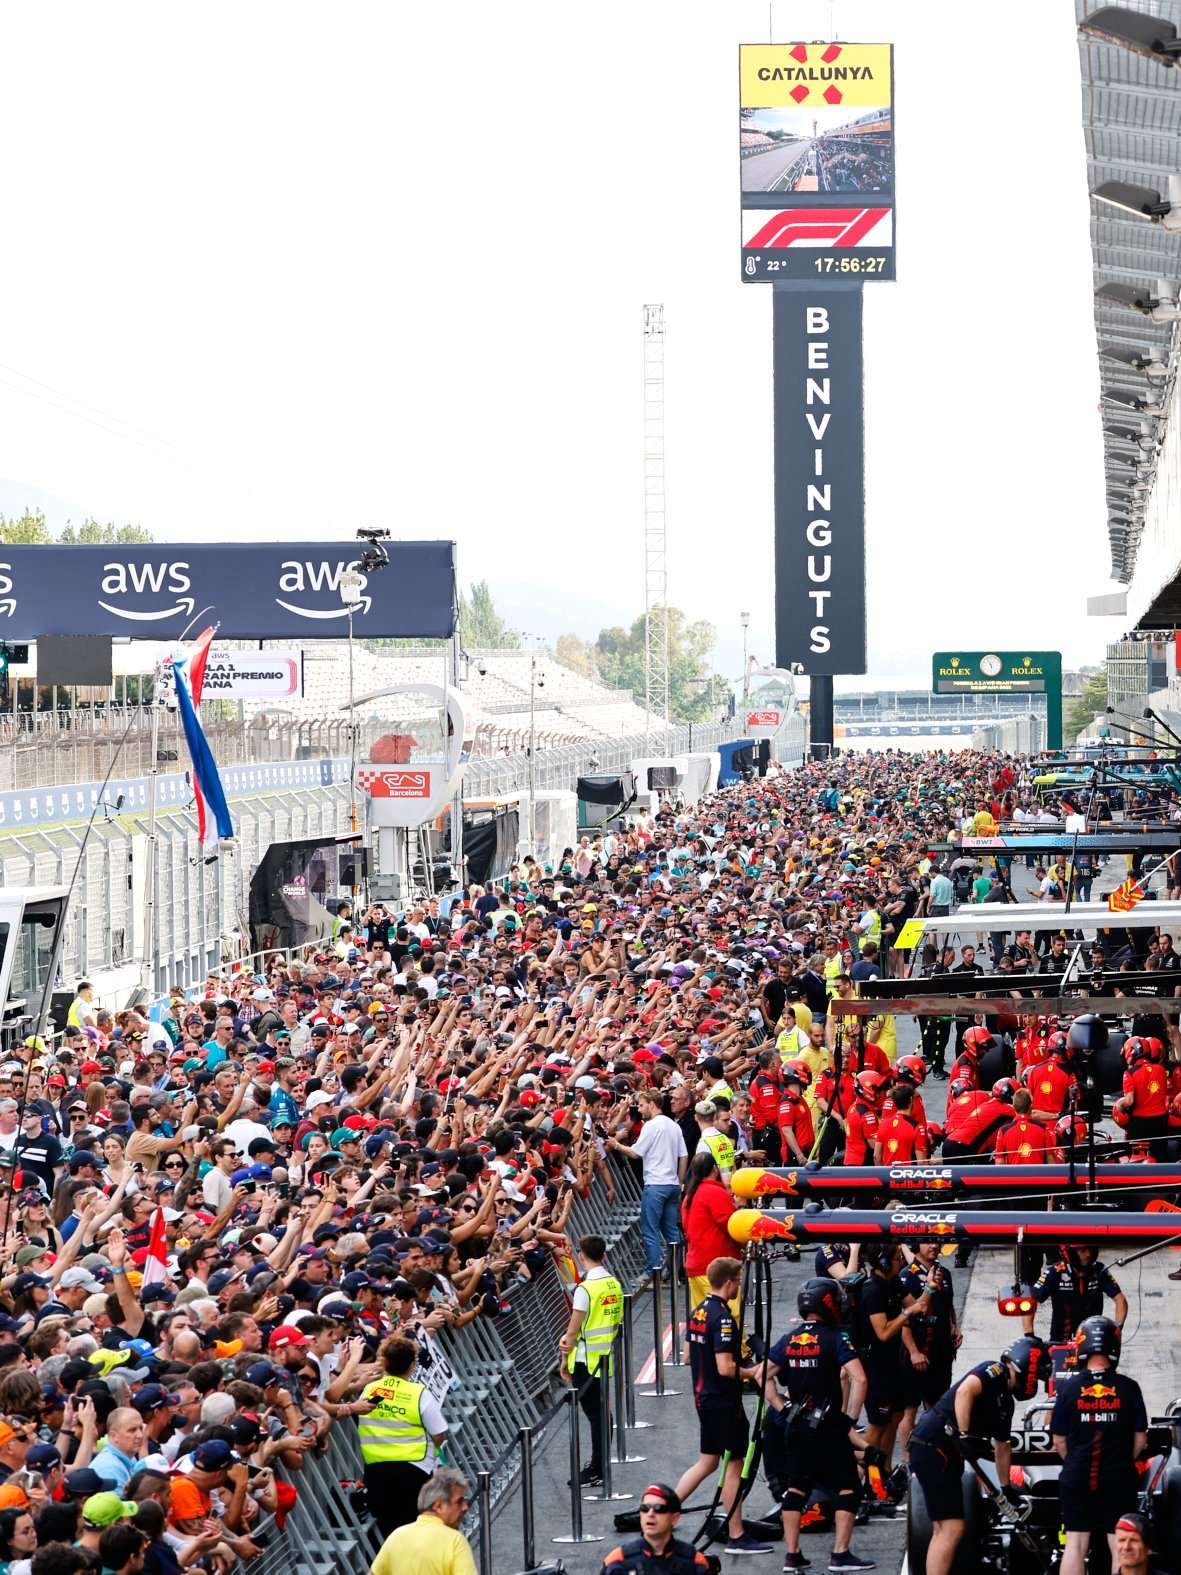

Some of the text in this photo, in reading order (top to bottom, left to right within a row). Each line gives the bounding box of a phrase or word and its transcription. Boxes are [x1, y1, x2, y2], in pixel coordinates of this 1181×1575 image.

[757, 67, 874, 81] CATALUNYA
[814, 258, 886, 273] 17:56:27
[805, 306, 832, 654] BENVINGUTS
[101, 561, 191, 594] aws
[232, 671, 284, 680] PREMIO
[939, 668, 971, 676] ROLEX
[1011, 667, 1043, 675] ROLEX
[889, 1169, 953, 1179] ORACLE
[889, 1180, 924, 1189] Red Bull
[891, 1213, 958, 1223] ORACLE
[889, 1224, 926, 1234] Red Bull
[1077, 1398, 1121, 1410] Red Bull
[1080, 1412, 1107, 1422] Mobil
